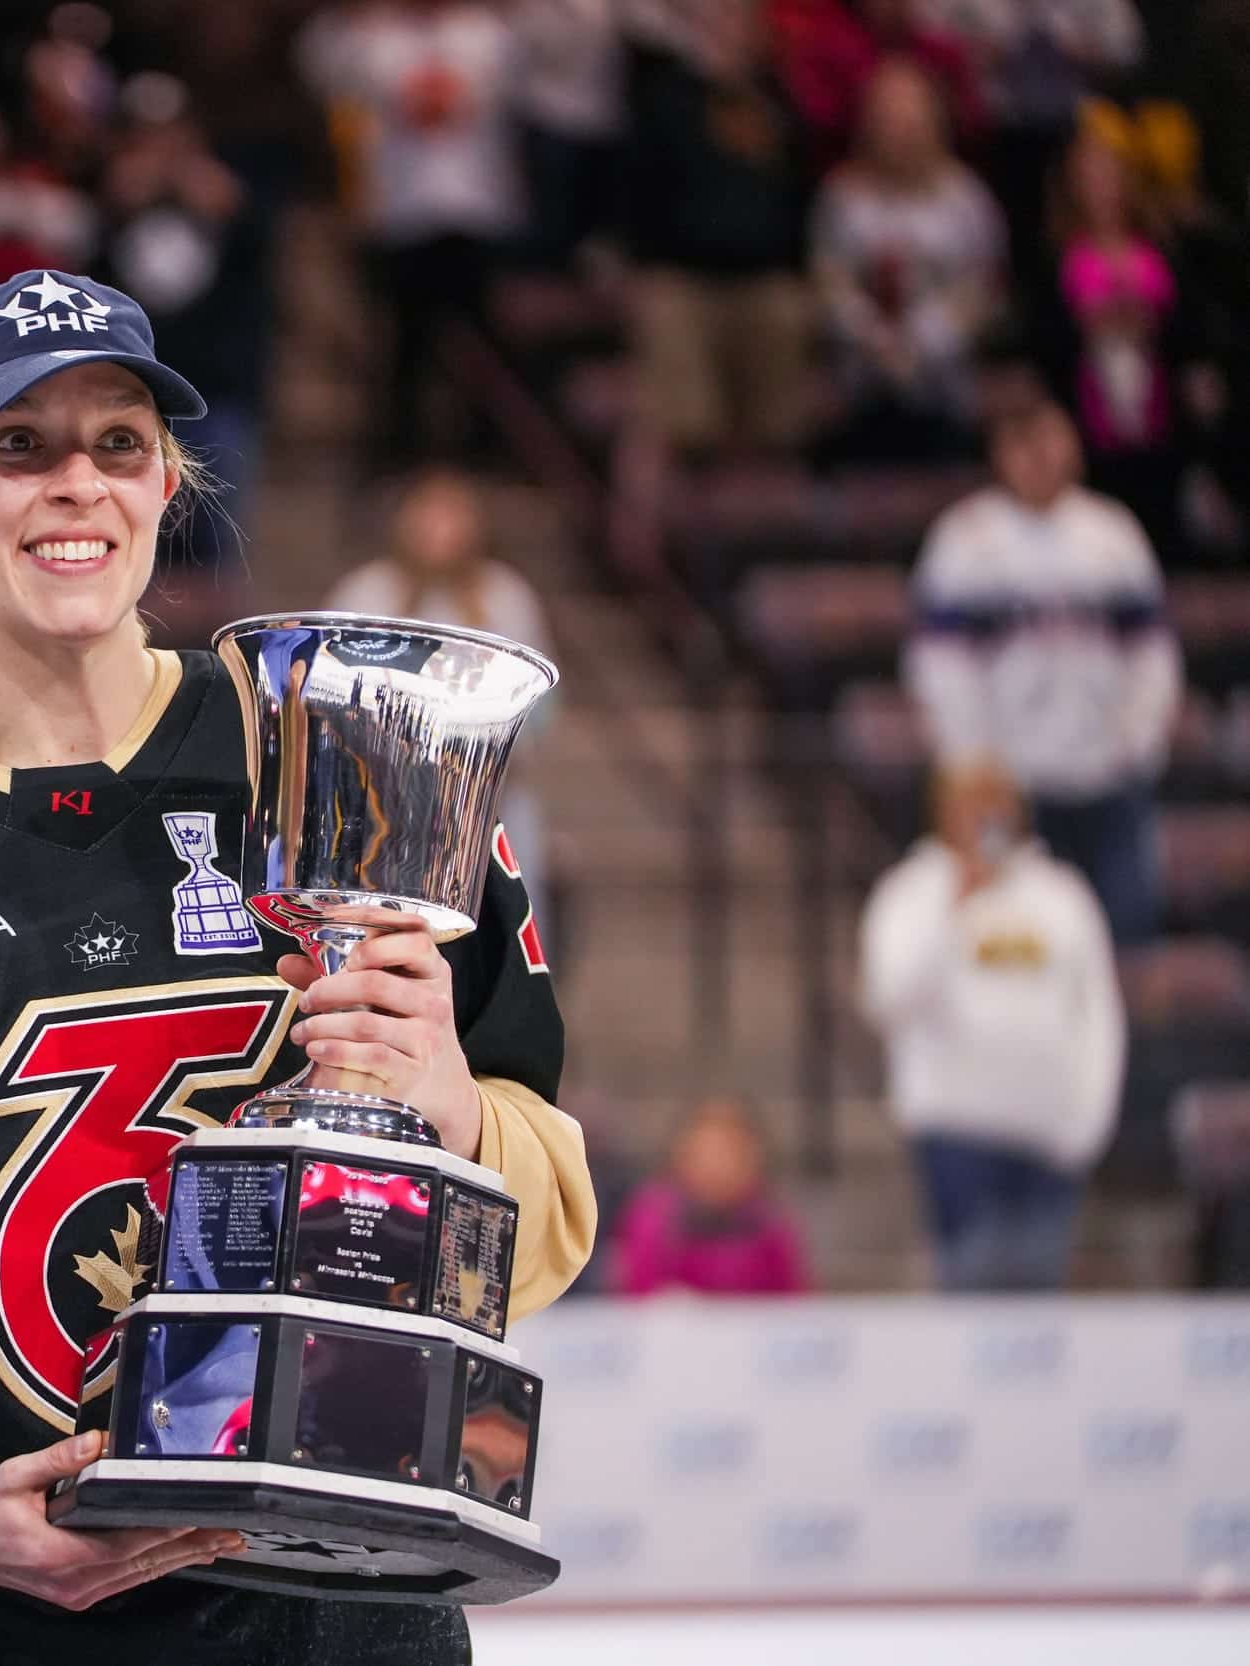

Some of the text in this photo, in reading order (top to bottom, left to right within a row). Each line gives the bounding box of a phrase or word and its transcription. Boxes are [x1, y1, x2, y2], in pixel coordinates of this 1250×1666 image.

[16, 311, 110, 338] PHF
[181, 838, 202, 846] PHF
[87, 949, 122, 965] PHF
